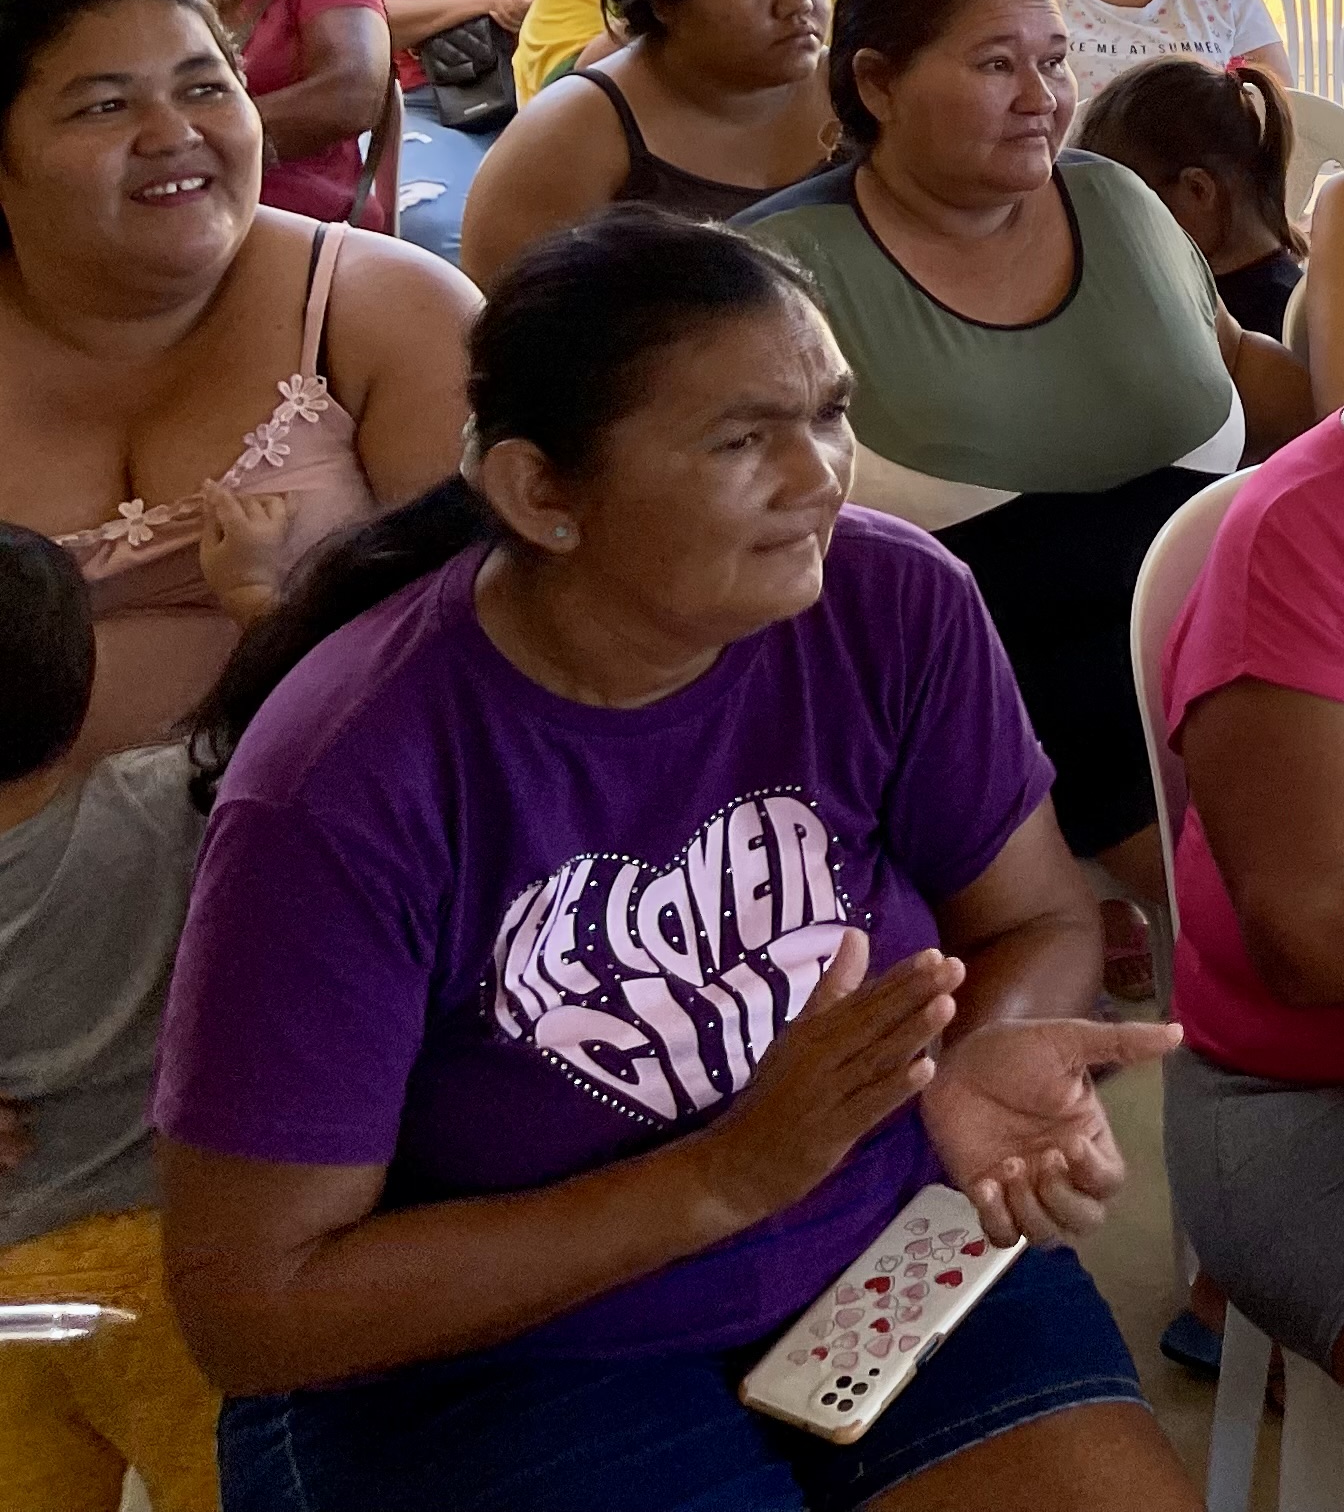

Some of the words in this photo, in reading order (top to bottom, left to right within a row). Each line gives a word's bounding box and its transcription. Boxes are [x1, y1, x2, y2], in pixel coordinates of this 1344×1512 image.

[1097, 42, 1117, 54] ME
[1130, 44, 1146, 55] AT
[1158, 41, 1222, 54] SUMMER
